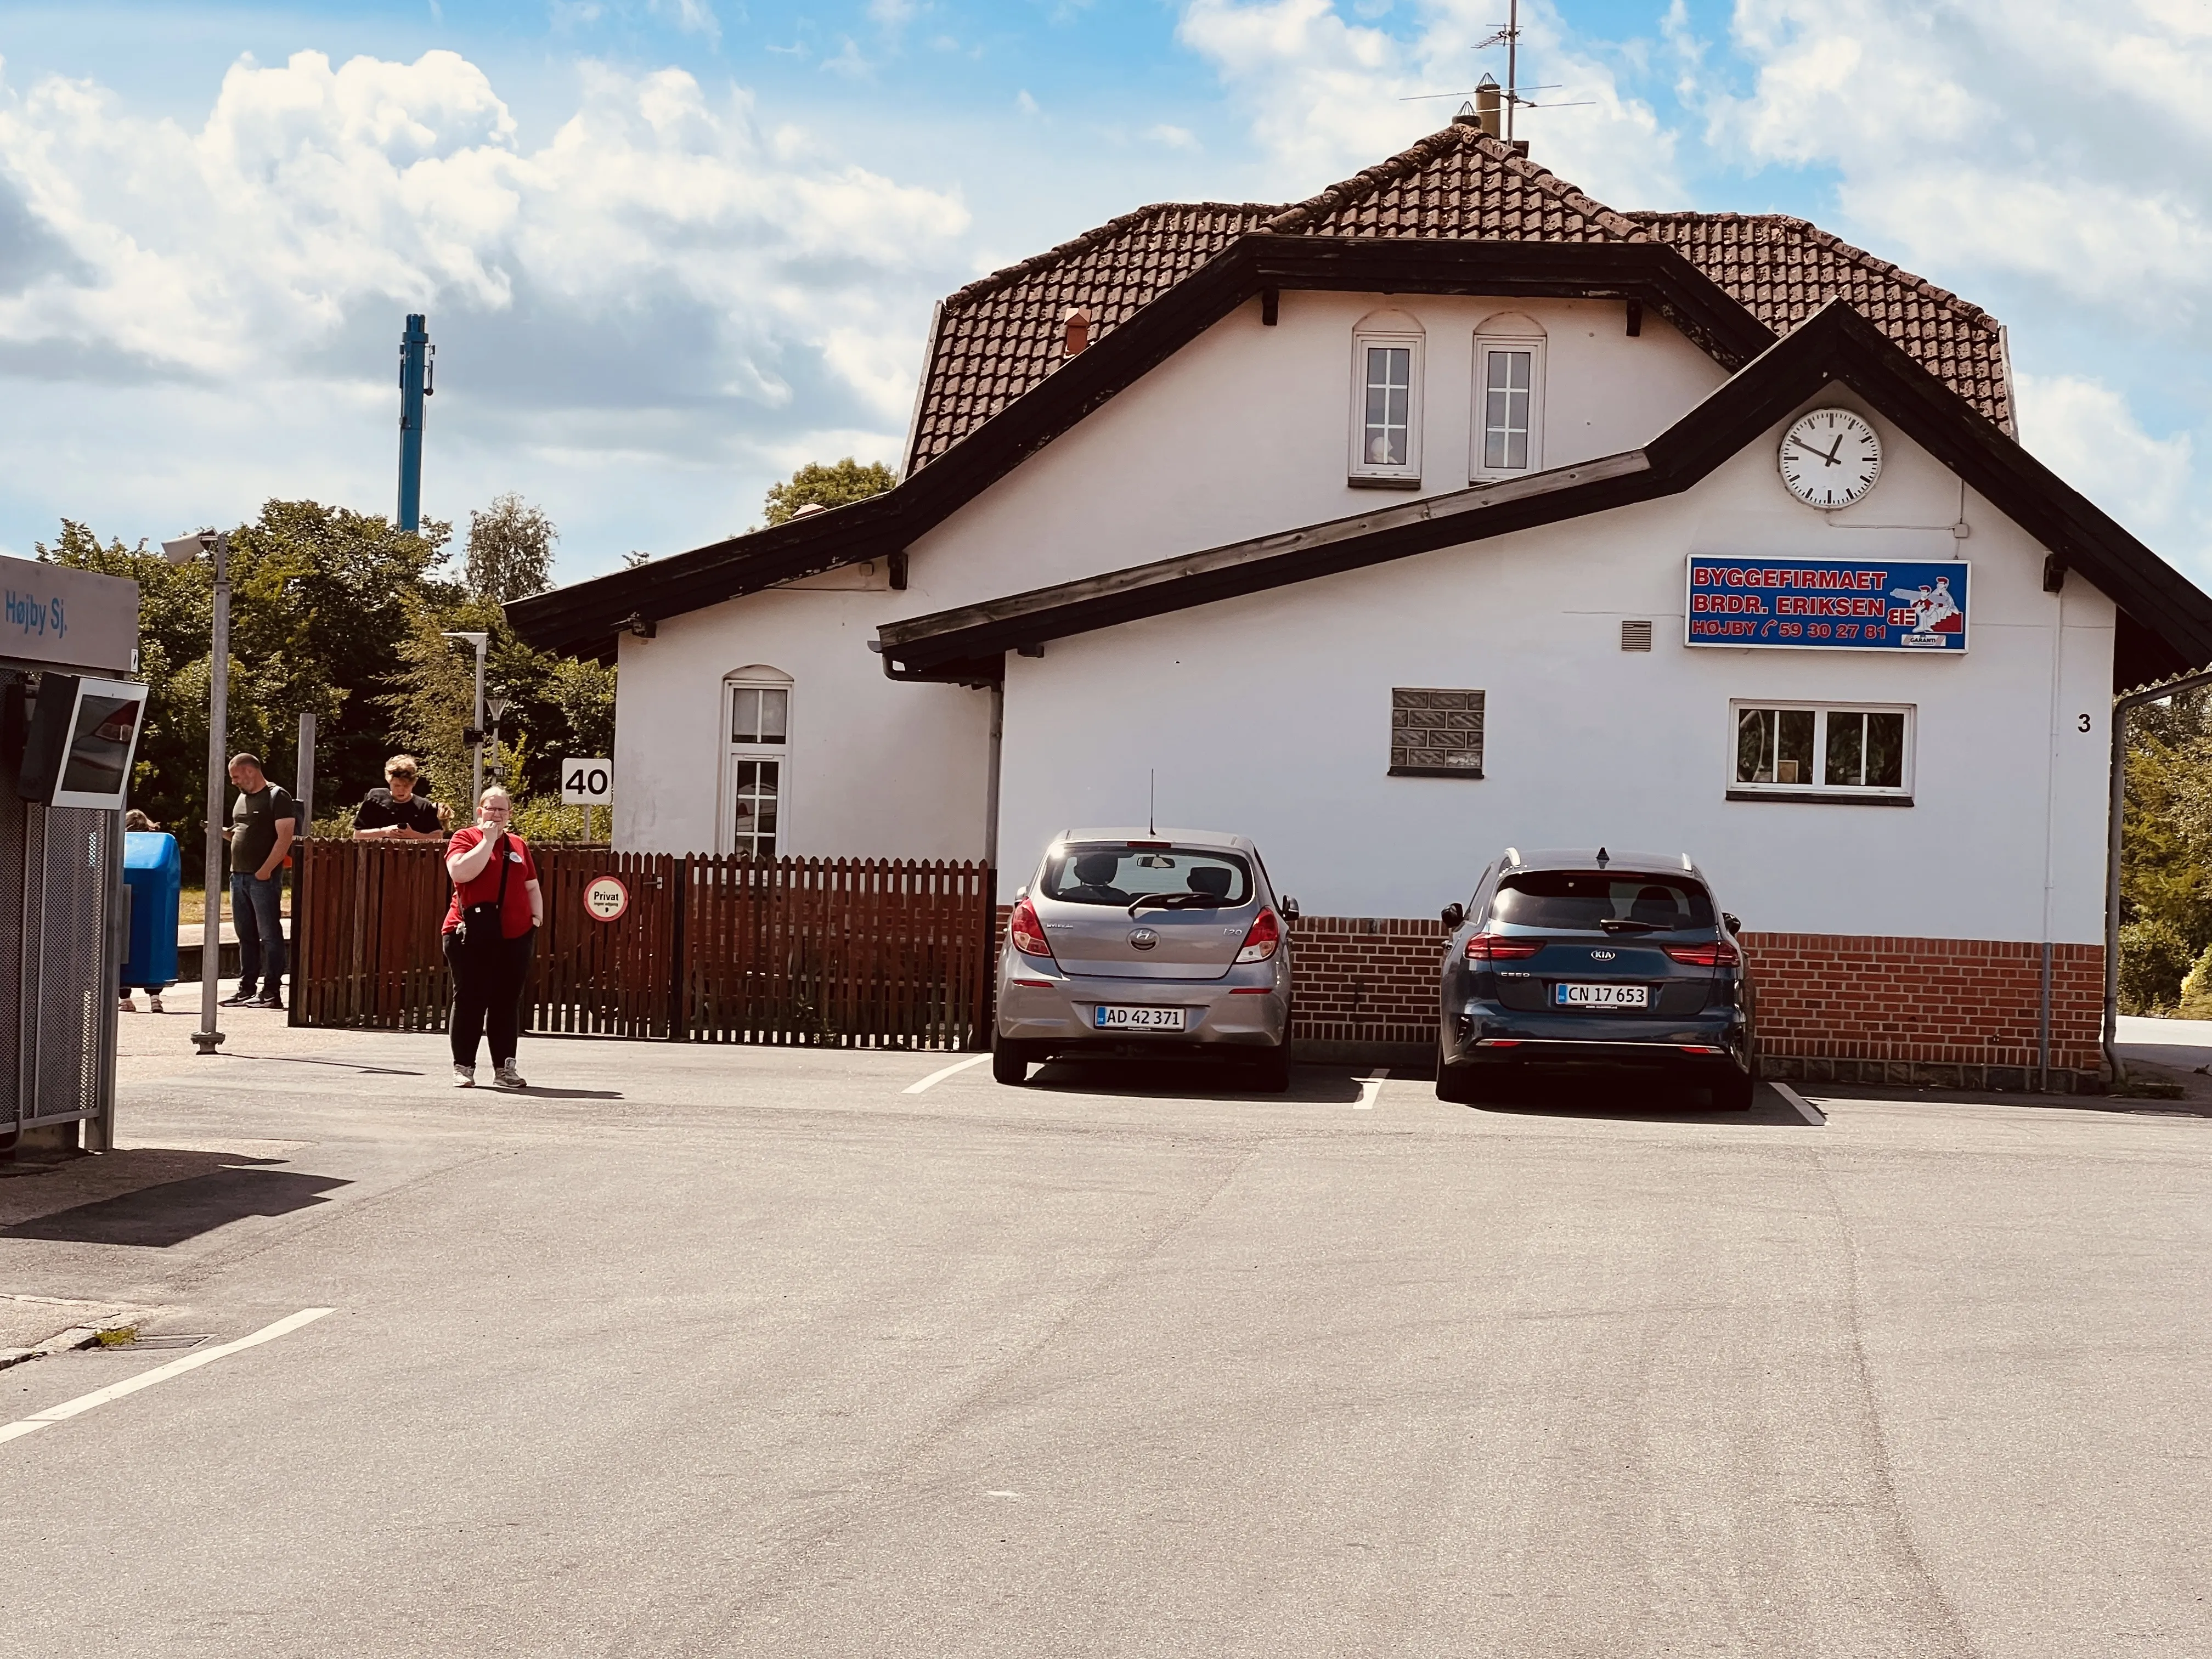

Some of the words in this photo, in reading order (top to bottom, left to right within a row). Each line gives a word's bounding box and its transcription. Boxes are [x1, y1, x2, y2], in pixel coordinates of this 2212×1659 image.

[1694, 567, 1887, 590] BYGGEFIRMAET
[5, 589, 46, 635] Højby
[50, 598, 67, 639] Sj.
[1692, 594, 1768, 614] BRDR.
[1776, 596, 1885, 617] ERIKSEN
[1692, 619, 1757, 635] HØJBY
[1779, 623, 1802, 637] 59
[1808, 623, 1831, 638] 30
[1836, 624, 1860, 639] 27
[1865, 624, 1886, 639] 81
[2078, 714, 2091, 733] 3
[566, 769, 608, 795] 40
[594, 891, 619, 901] Privat
[1568, 987, 1589, 1001] CN
[1595, 988, 1612, 1002] 17
[1616, 988, 1644, 1003] 653
[1107, 1009, 1127, 1023] AD
[1131, 1010, 1149, 1024] 42
[1153, 1011, 1180, 1025] 371
